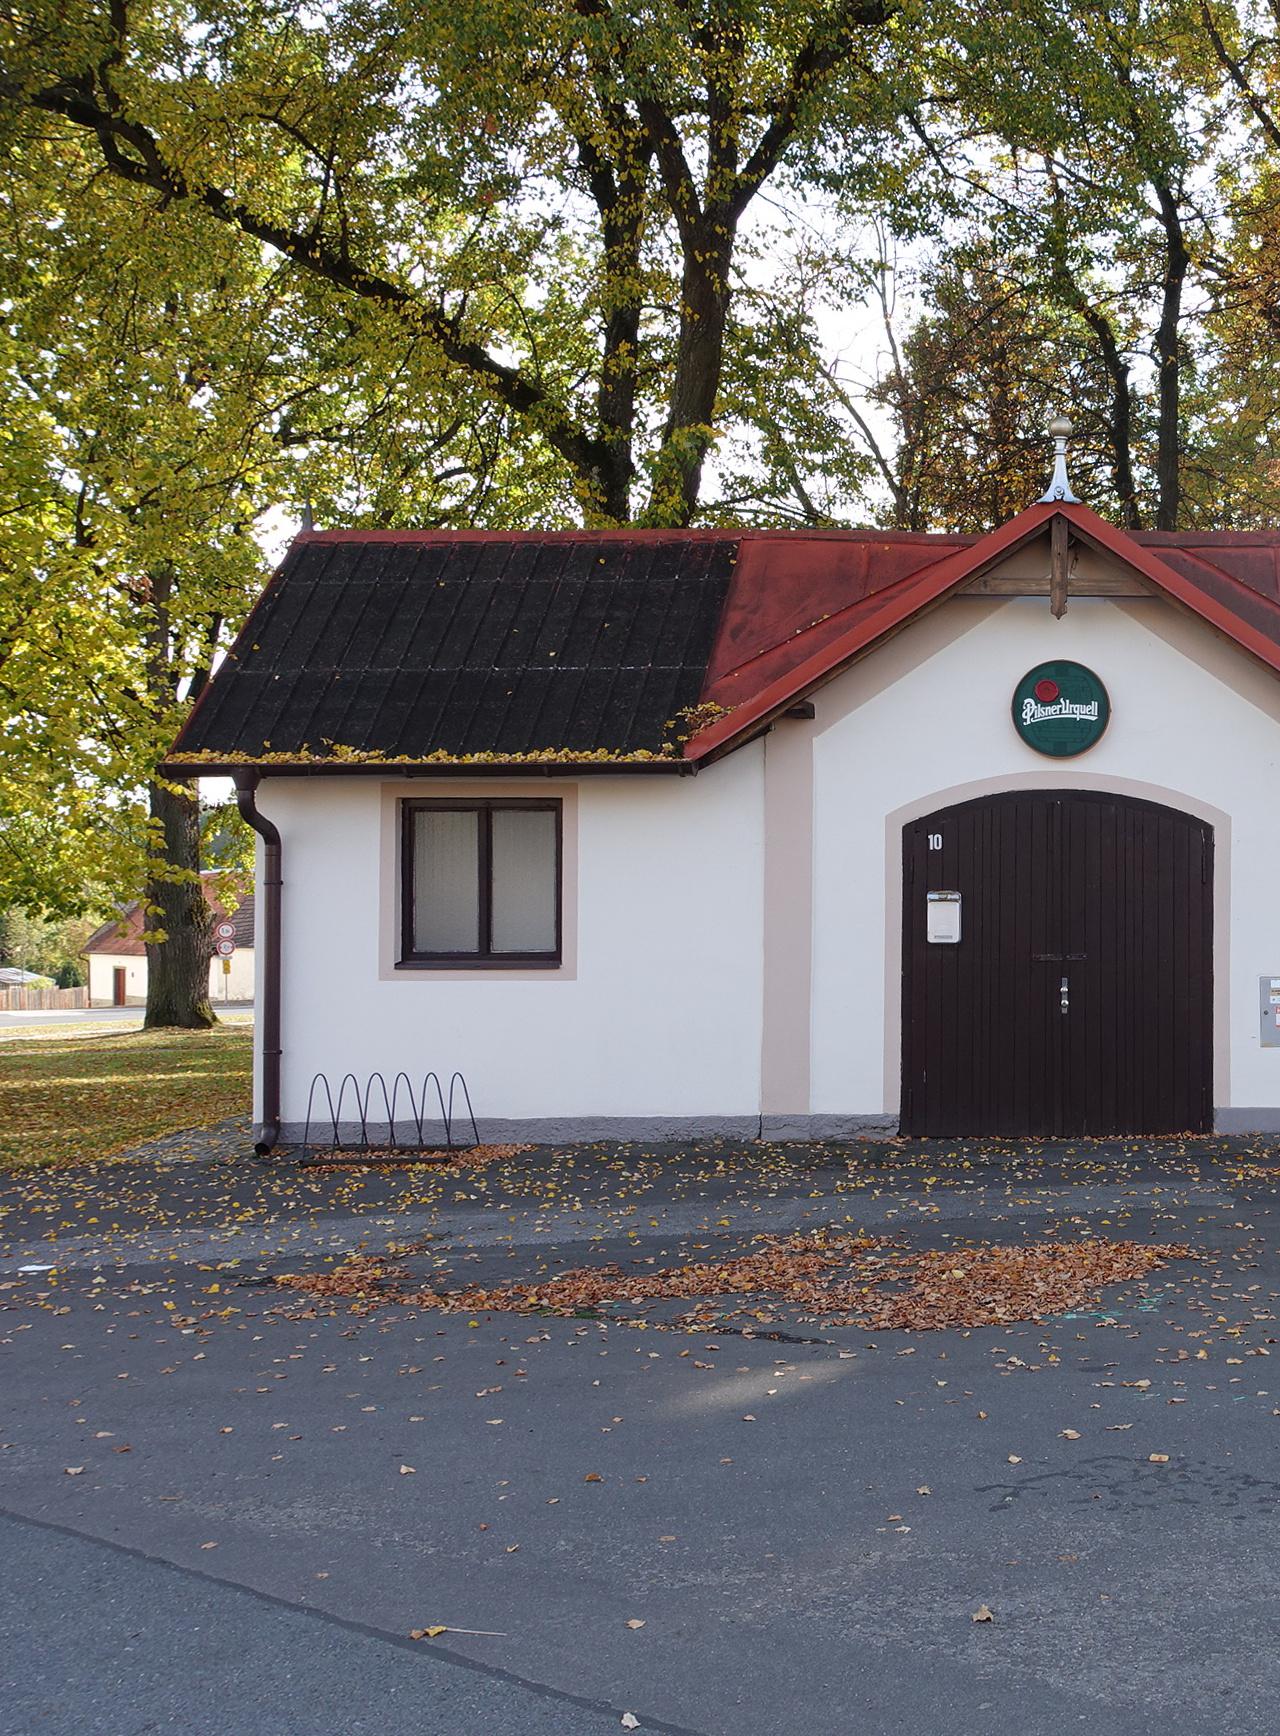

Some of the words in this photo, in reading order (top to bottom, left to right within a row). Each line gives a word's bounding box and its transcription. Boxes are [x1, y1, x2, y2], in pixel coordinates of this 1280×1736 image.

[1022, 698, 1060, 725] Pilsner
[1060, 697, 1098, 721] Urquell
[928, 834, 942, 850] 10
